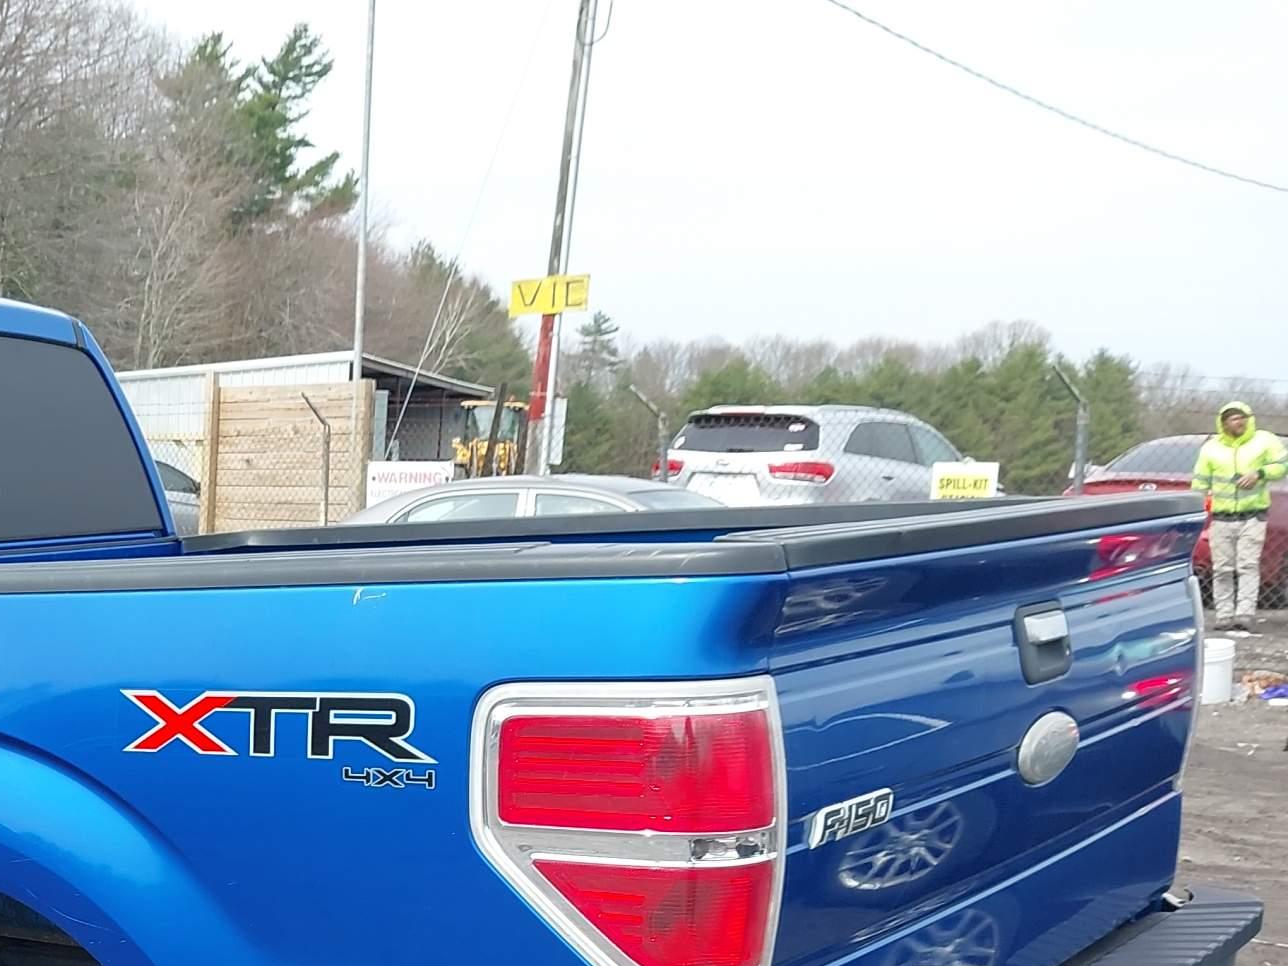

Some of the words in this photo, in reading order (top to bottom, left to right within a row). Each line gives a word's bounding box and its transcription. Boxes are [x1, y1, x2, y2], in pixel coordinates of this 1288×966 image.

[518, 279, 585, 308] VIC
[376, 471, 444, 484] WARNING
[939, 478, 989, 490] SPILL-KIT
[119, 689, 440, 764] XTR
